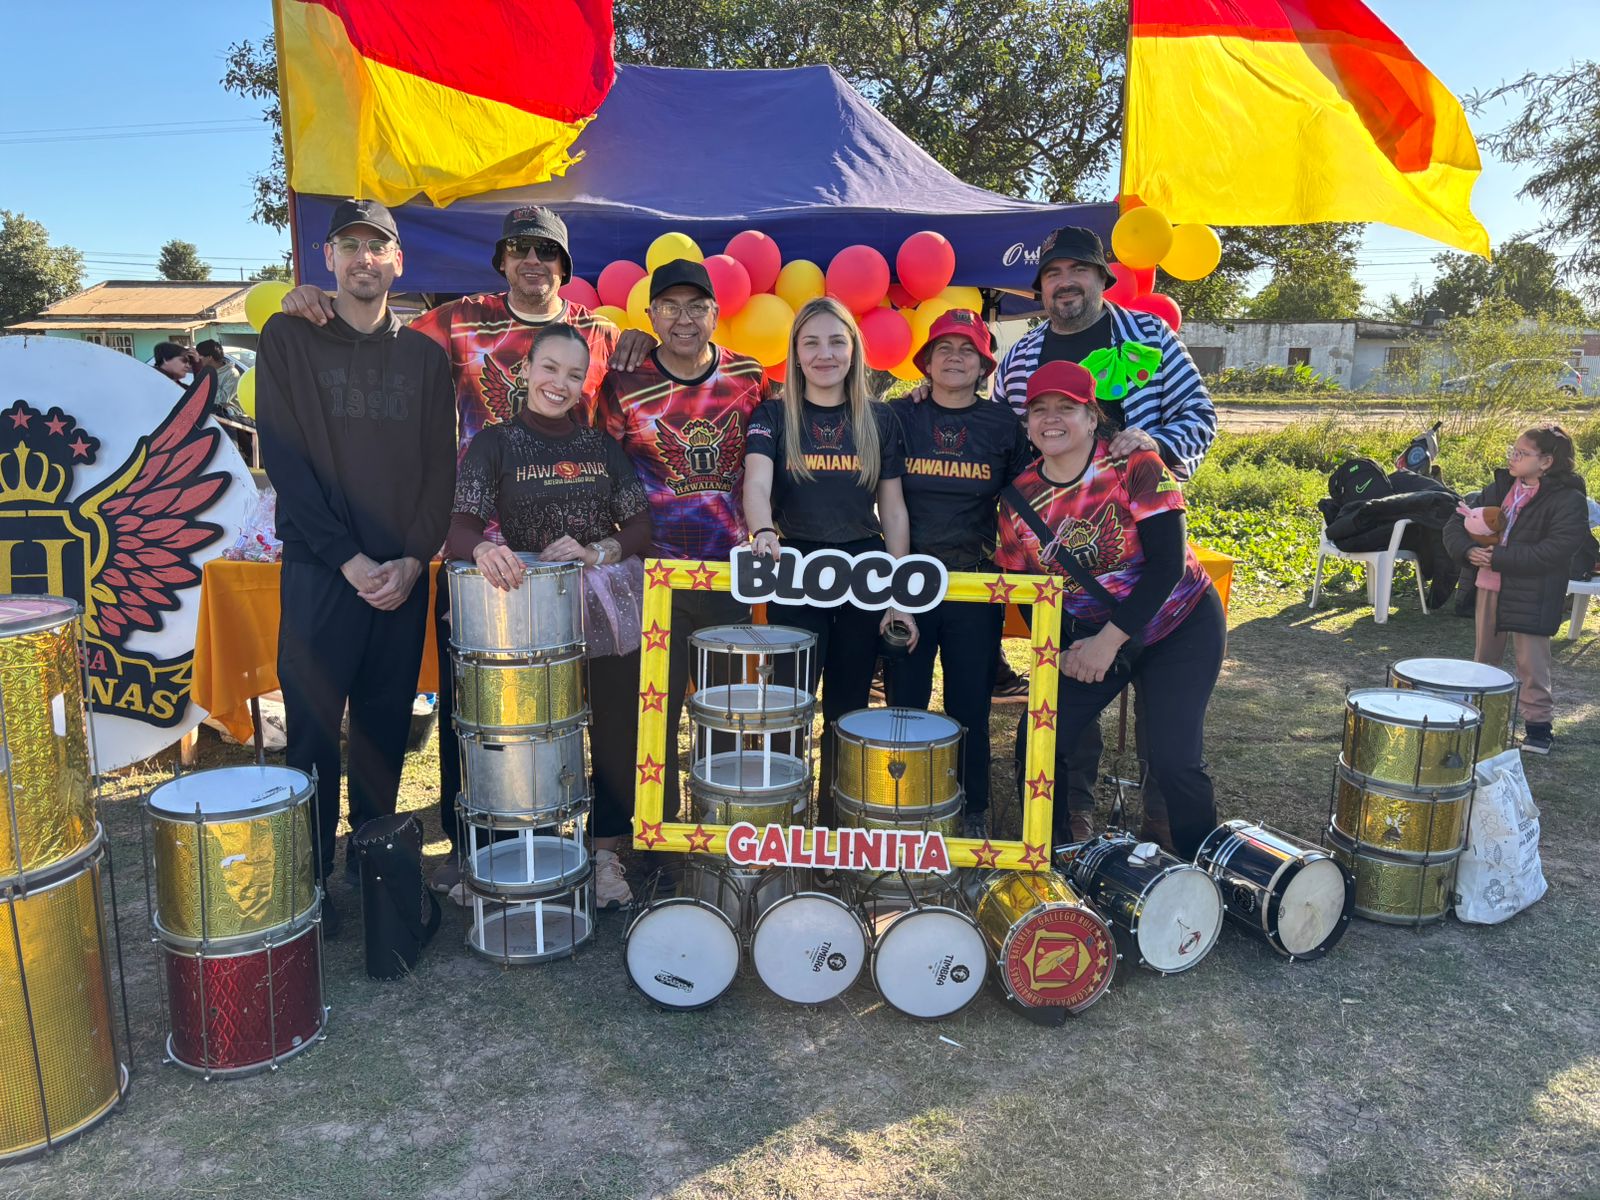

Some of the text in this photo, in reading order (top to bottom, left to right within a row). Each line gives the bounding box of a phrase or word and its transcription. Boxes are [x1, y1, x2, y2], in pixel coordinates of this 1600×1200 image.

[904, 457, 991, 480] HAWAIANAS
[733, 548, 945, 610] BLOCO
[727, 822, 950, 872] GALLINITA
[1037, 911, 1077, 926] GALLEGO
[1078, 915, 1097, 933] RUIZ
[812, 941, 832, 972] TIMBRA
[935, 954, 954, 986] TIMBRA
